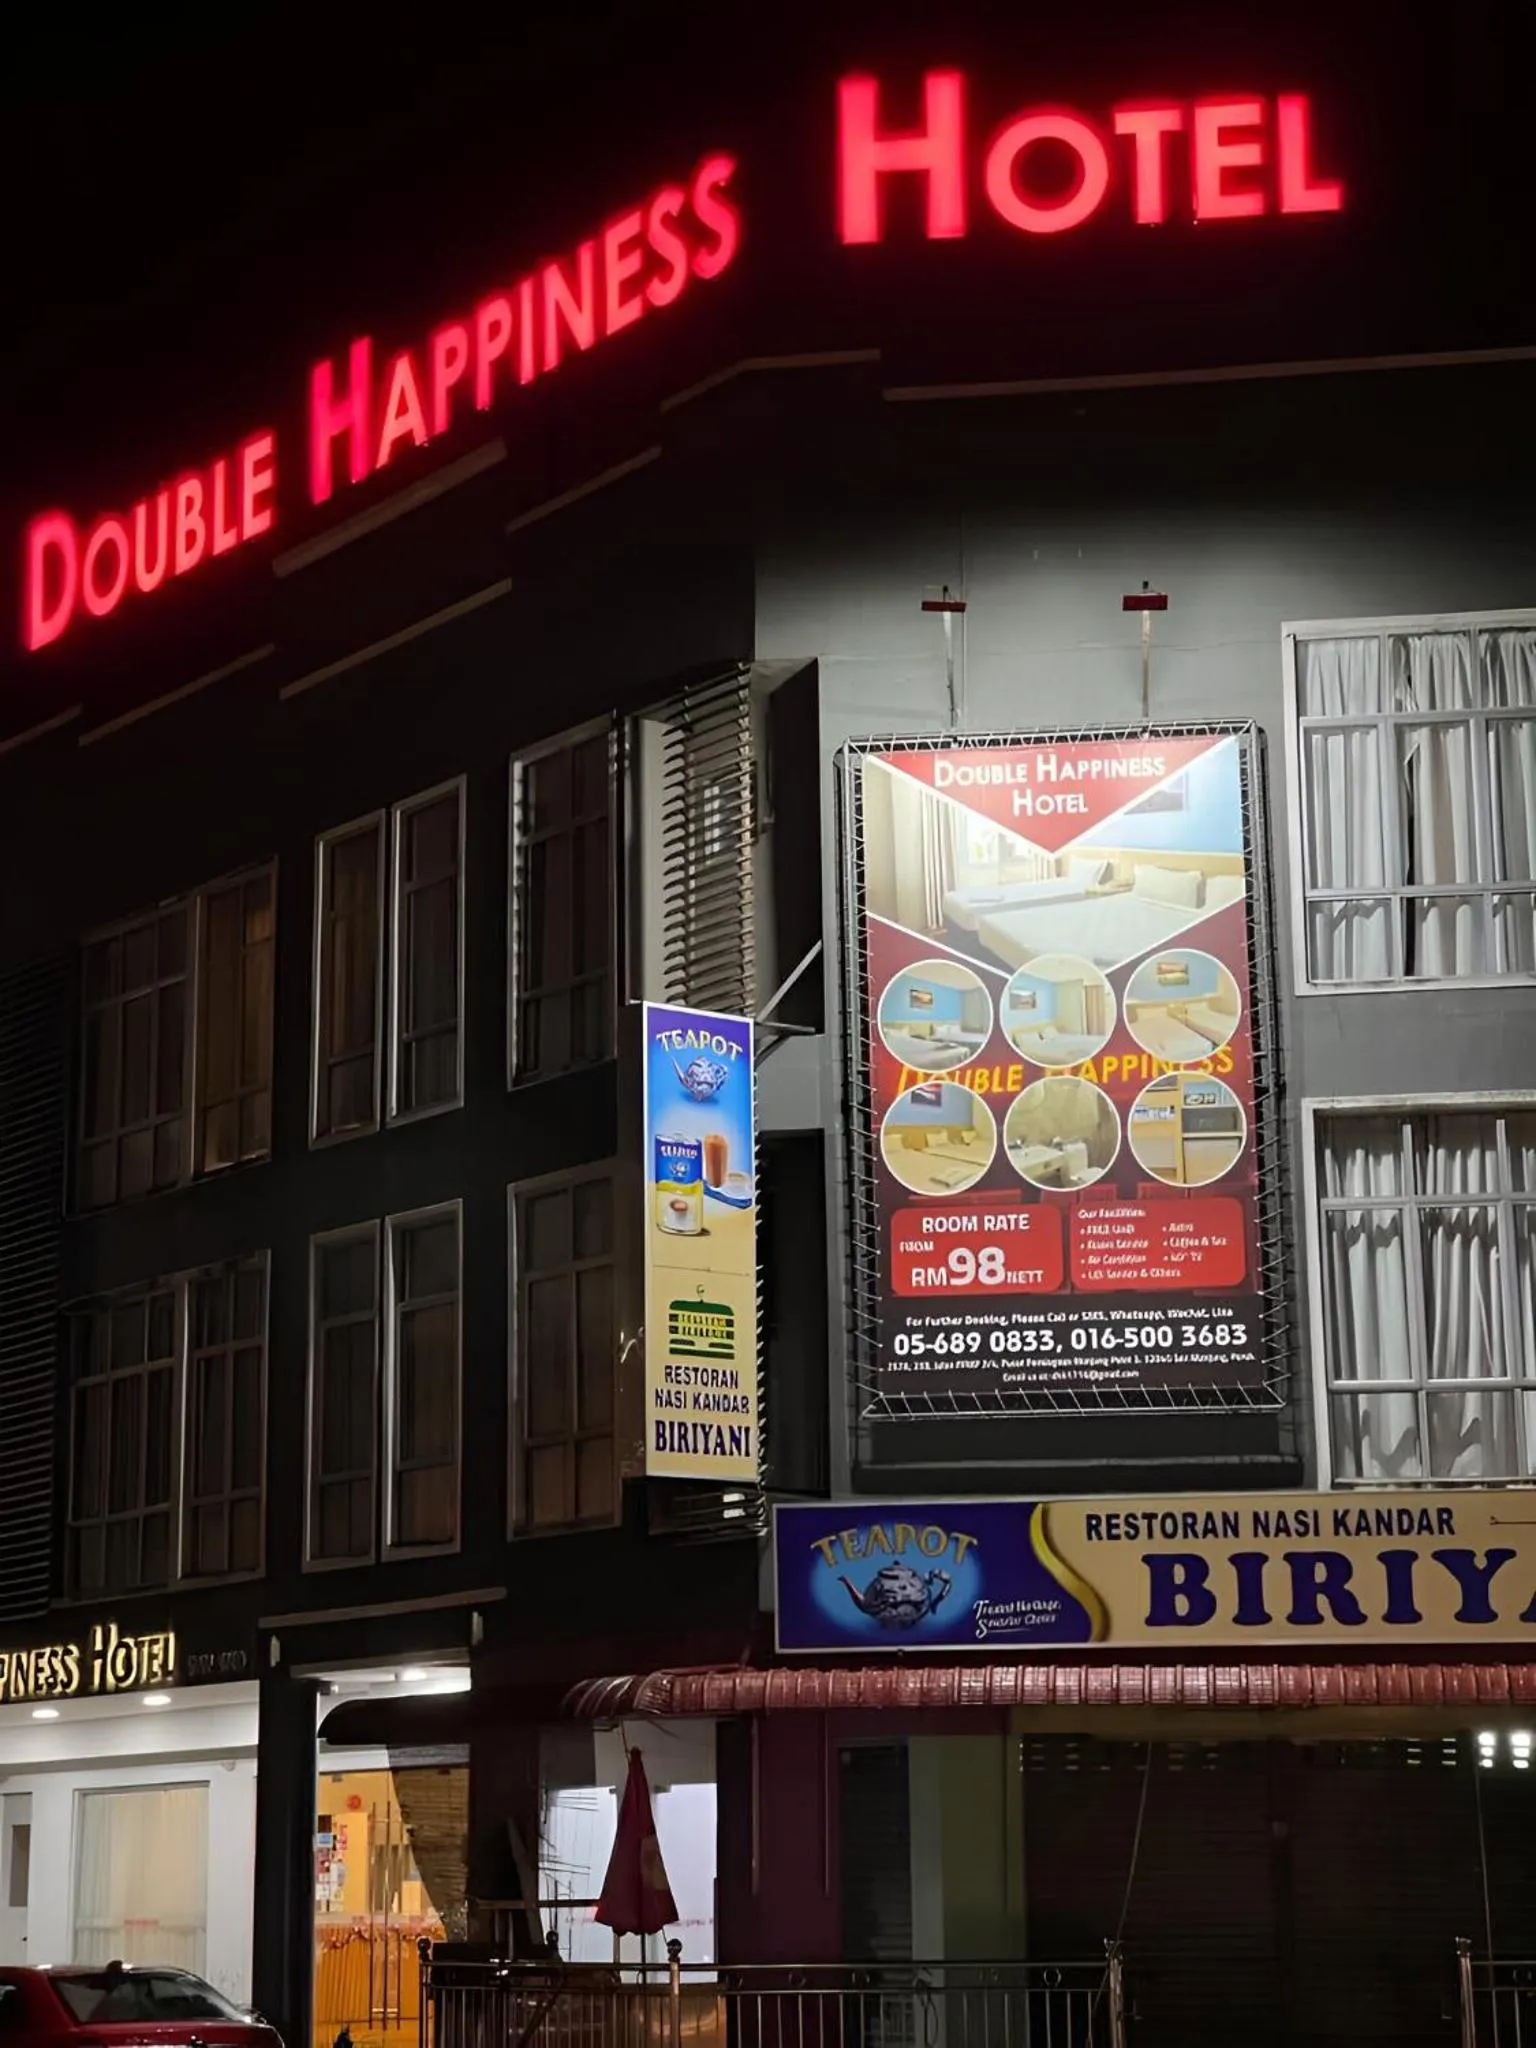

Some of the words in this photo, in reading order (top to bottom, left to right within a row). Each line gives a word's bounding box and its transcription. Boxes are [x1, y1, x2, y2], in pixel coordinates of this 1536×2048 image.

[28, 431, 276, 652] DOUBLE
[311, 153, 740, 505] HAPPINESS
[837, 71, 1342, 245] HOTEL
[934, 760, 1028, 788] DOUBLE
[1036, 754, 1166, 783] HAPPINESS
[1012, 788, 1089, 817] HOTEL
[656, 1028, 743, 1062] TEAPOT
[922, 1216, 978, 1233] ROOM
[984, 1214, 1030, 1231] RATE
[894, 1332, 981, 1355] 05-689
[989, 1330, 1063, 1353] 0833,
[1071, 1326, 1173, 1350] 016-500
[1181, 1324, 1248, 1347] 3683
[664, 1365, 738, 1389] RESTORAN
[655, 1388, 687, 1409] NASI
[693, 1392, 749, 1414] KANDAR
[655, 1419, 750, 1458] BIRIYANI
[1086, 1511, 1239, 1540] RESTORAN
[1253, 1509, 1320, 1537] NASI
[1333, 1507, 1455, 1536] KANDAR
[811, 1523, 978, 1567] TEAPOT
[1141, 1549, 1536, 1626] BIRIY
[90, 1624, 175, 1692] HOTEL
